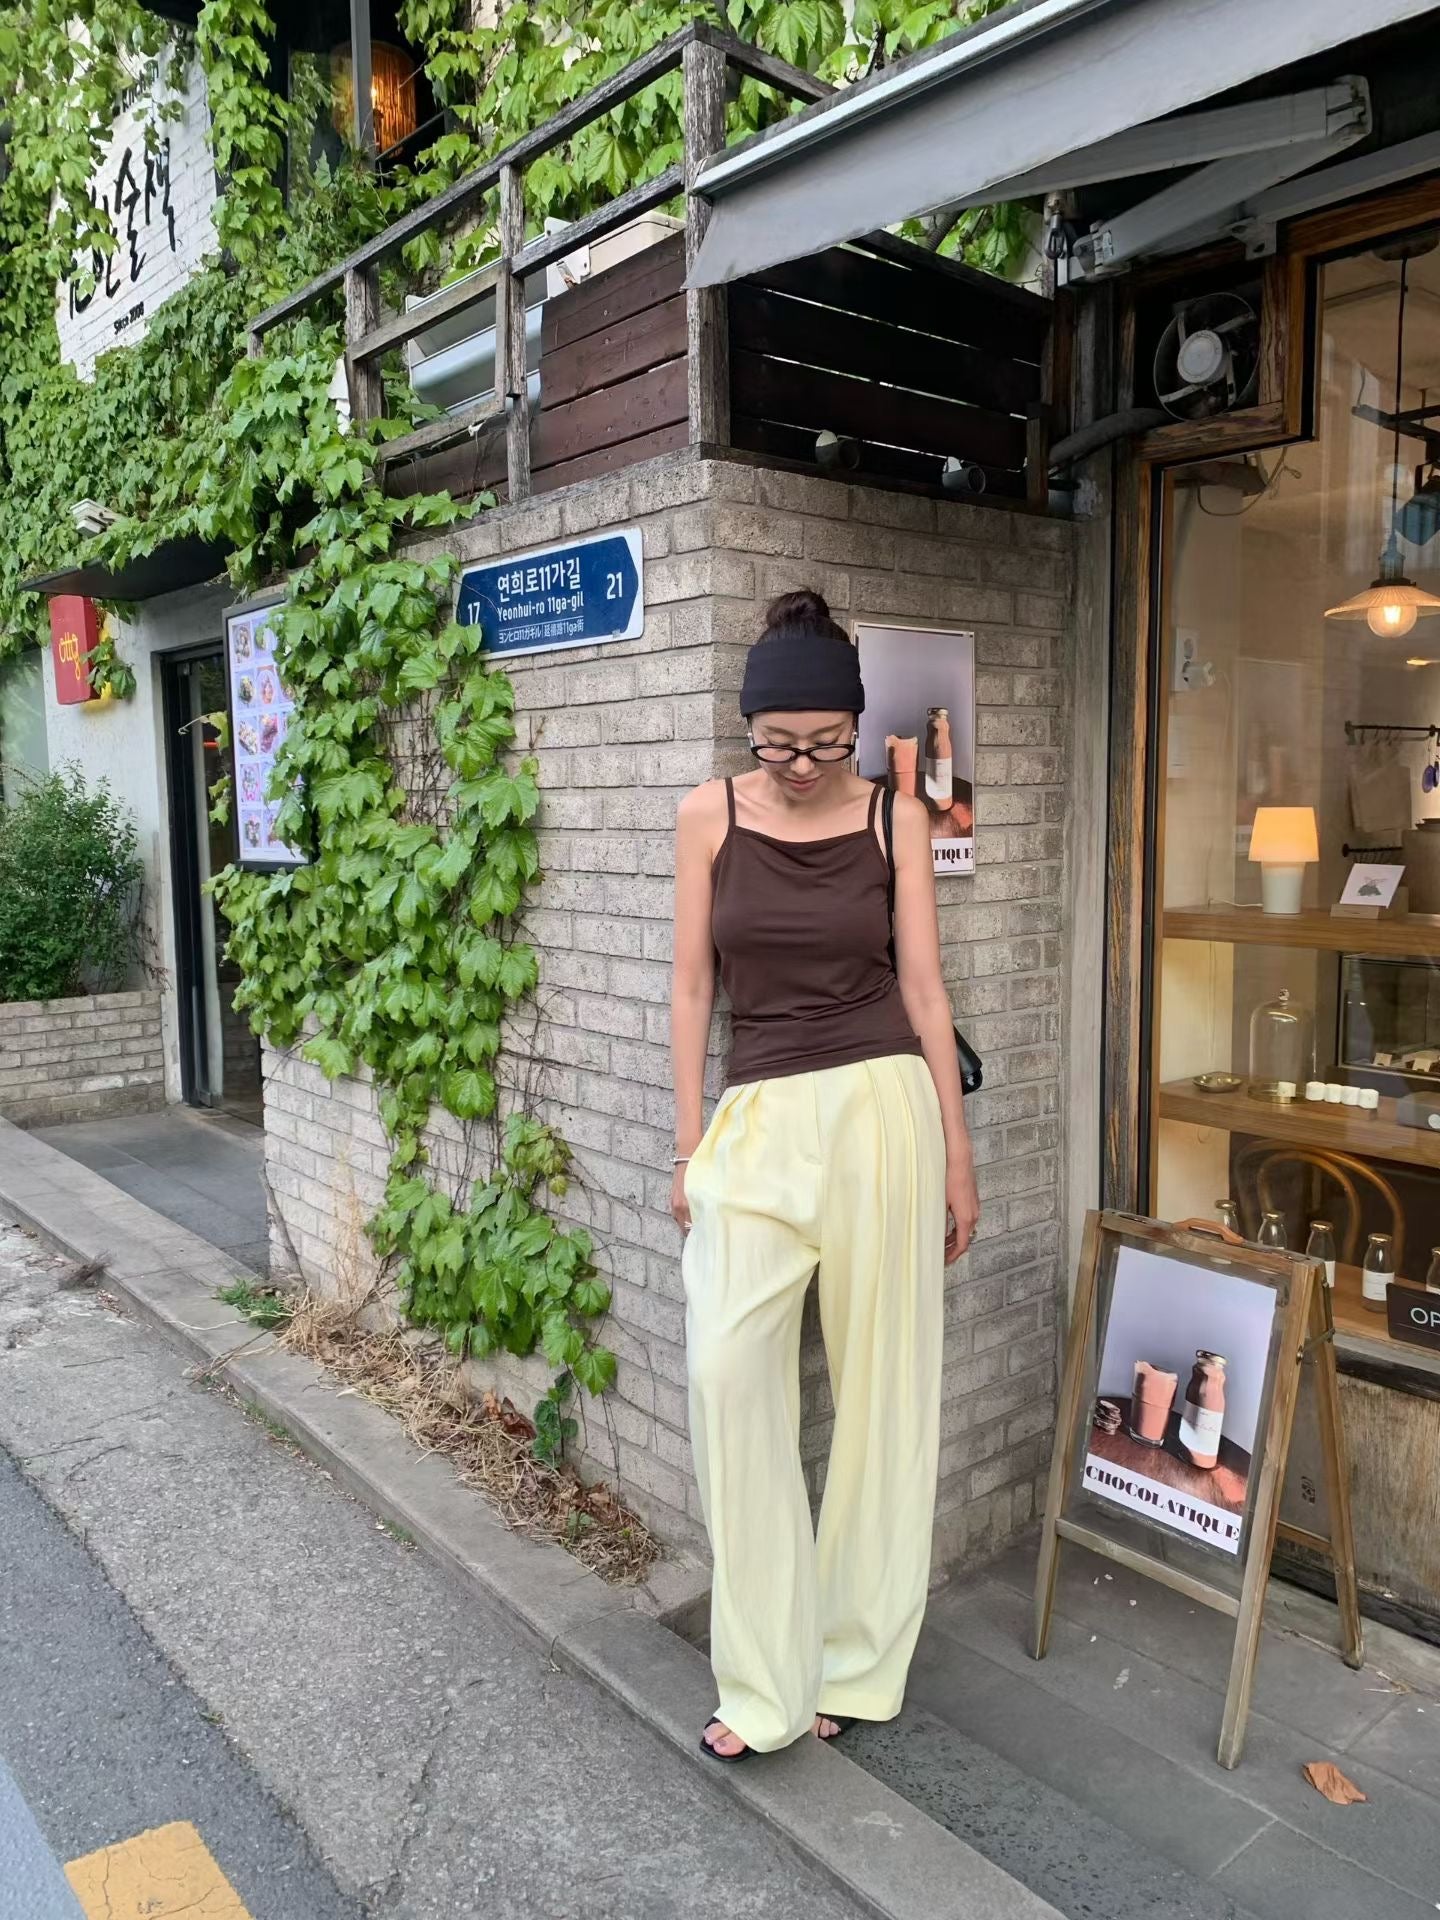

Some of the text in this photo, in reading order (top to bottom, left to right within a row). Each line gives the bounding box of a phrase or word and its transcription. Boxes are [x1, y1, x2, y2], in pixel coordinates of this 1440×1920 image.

[497, 557, 581, 603] 연희로11가길
[606, 572, 623, 600] 21
[467, 601, 481, 625] 17
[497, 592, 584, 622] Yeonhui-ro 11ga-gil
[934, 847, 973, 863] TIQUE
[1085, 1465, 1240, 1542] CHOCOLATIQUE
